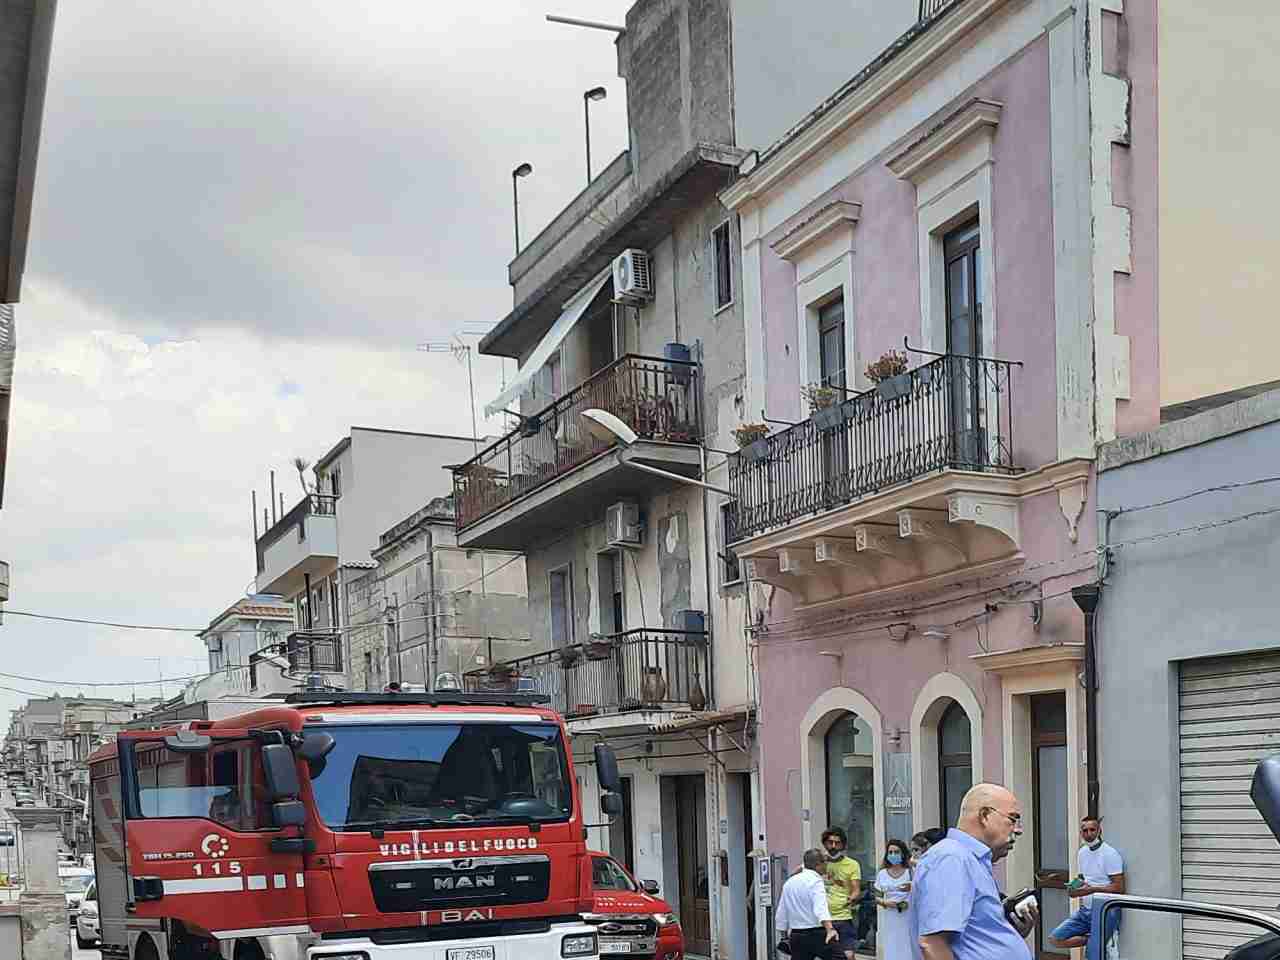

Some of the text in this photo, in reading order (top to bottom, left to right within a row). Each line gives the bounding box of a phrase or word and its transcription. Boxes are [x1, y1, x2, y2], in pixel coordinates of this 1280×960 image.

[379, 837, 538, 856] VIGILI DEL FUOCO
[433, 874, 496, 891] MAN
[441, 908, 494, 923] BAI
